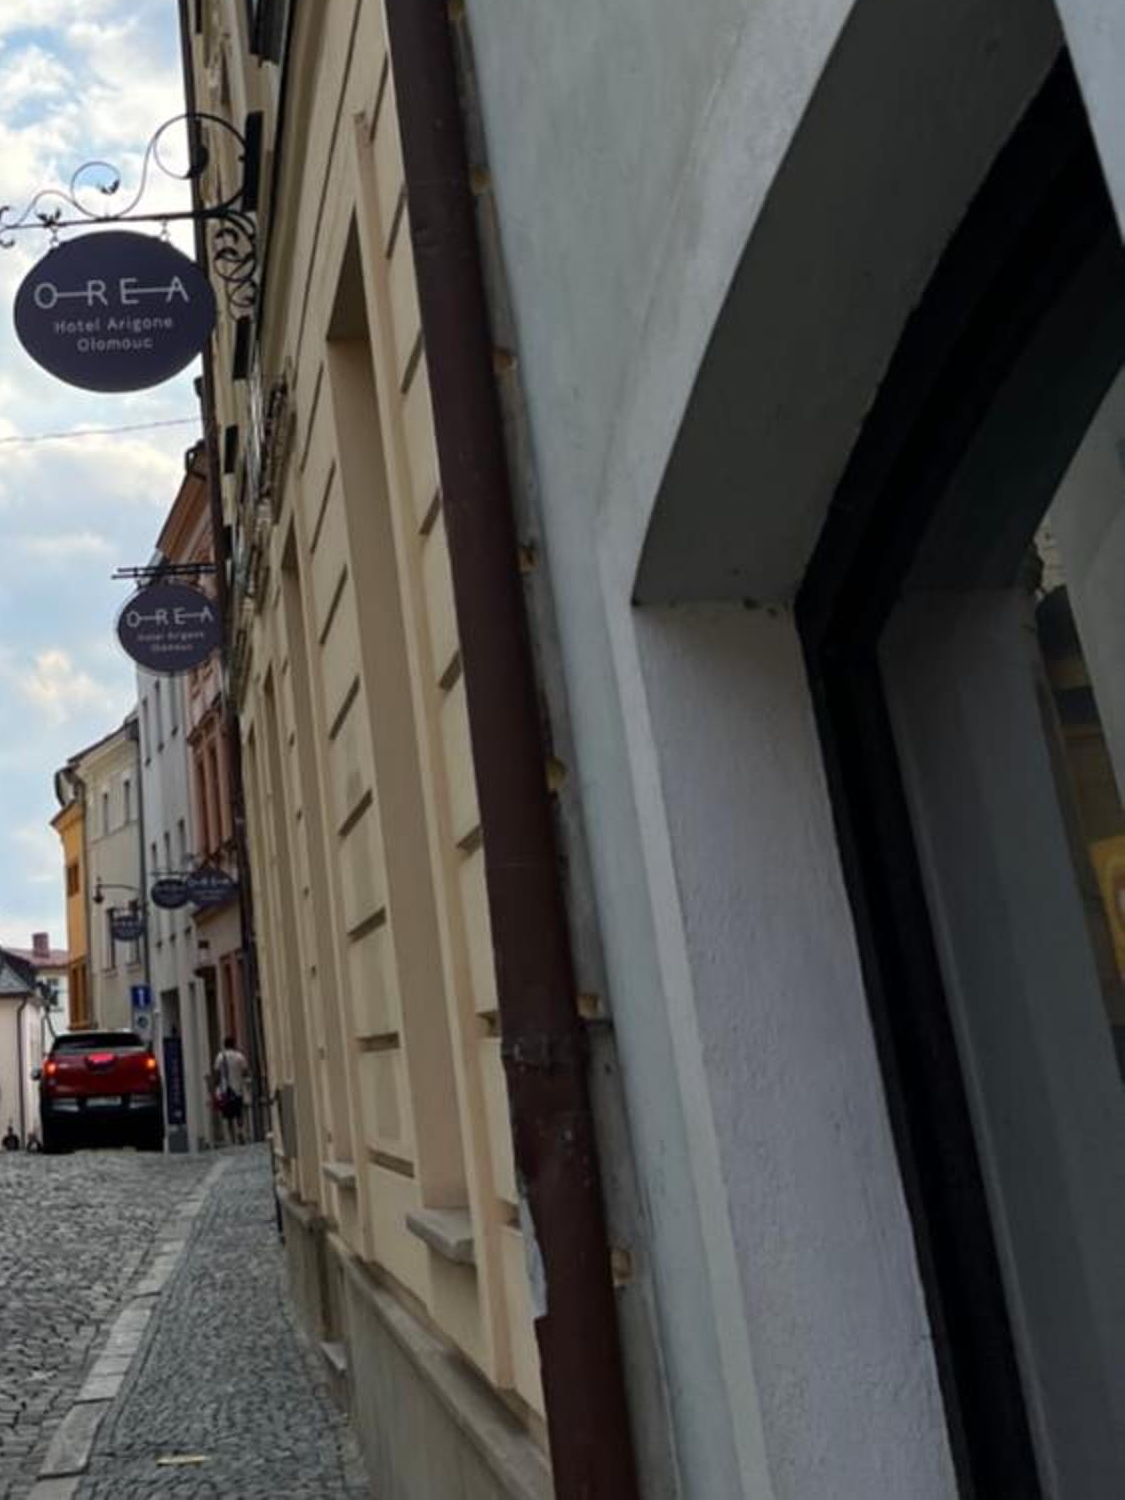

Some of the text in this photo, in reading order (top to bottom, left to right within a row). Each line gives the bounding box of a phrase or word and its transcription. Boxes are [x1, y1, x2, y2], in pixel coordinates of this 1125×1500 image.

[53, 314, 174, 334] Hotel Arigone
[76, 337, 154, 353] Olomouc
